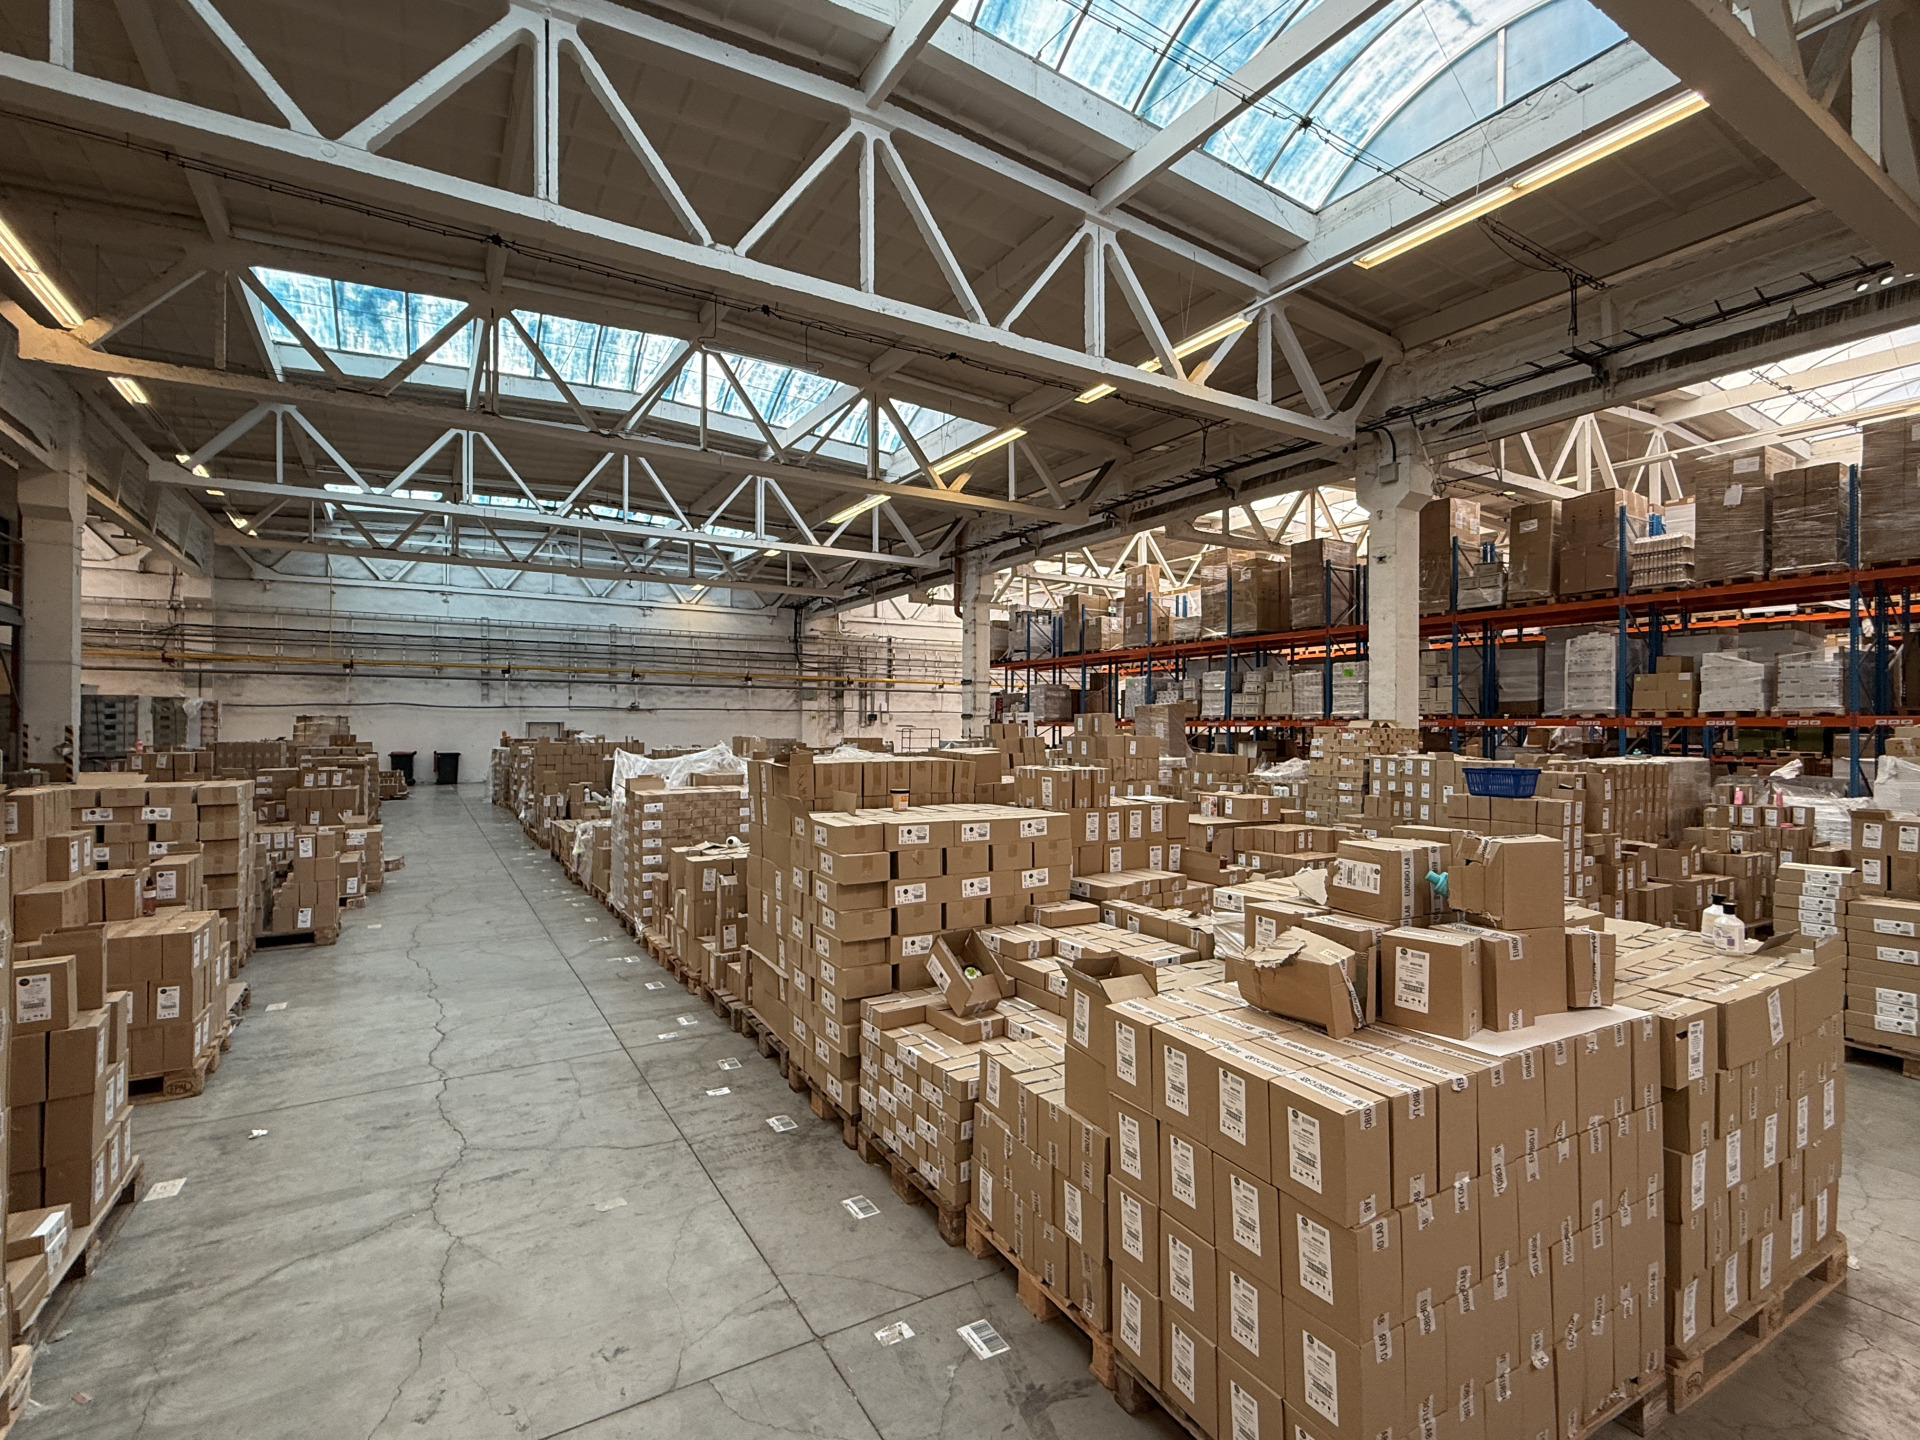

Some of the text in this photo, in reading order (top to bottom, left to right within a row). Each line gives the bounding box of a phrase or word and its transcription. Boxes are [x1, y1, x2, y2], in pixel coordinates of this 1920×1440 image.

[1403, 857, 1412, 897] EUROBIO LAB
[1493, 1069, 1501, 1085] LAB
[1376, 1222, 1385, 1239] LAB
[1378, 1334, 1388, 1352] LAB
